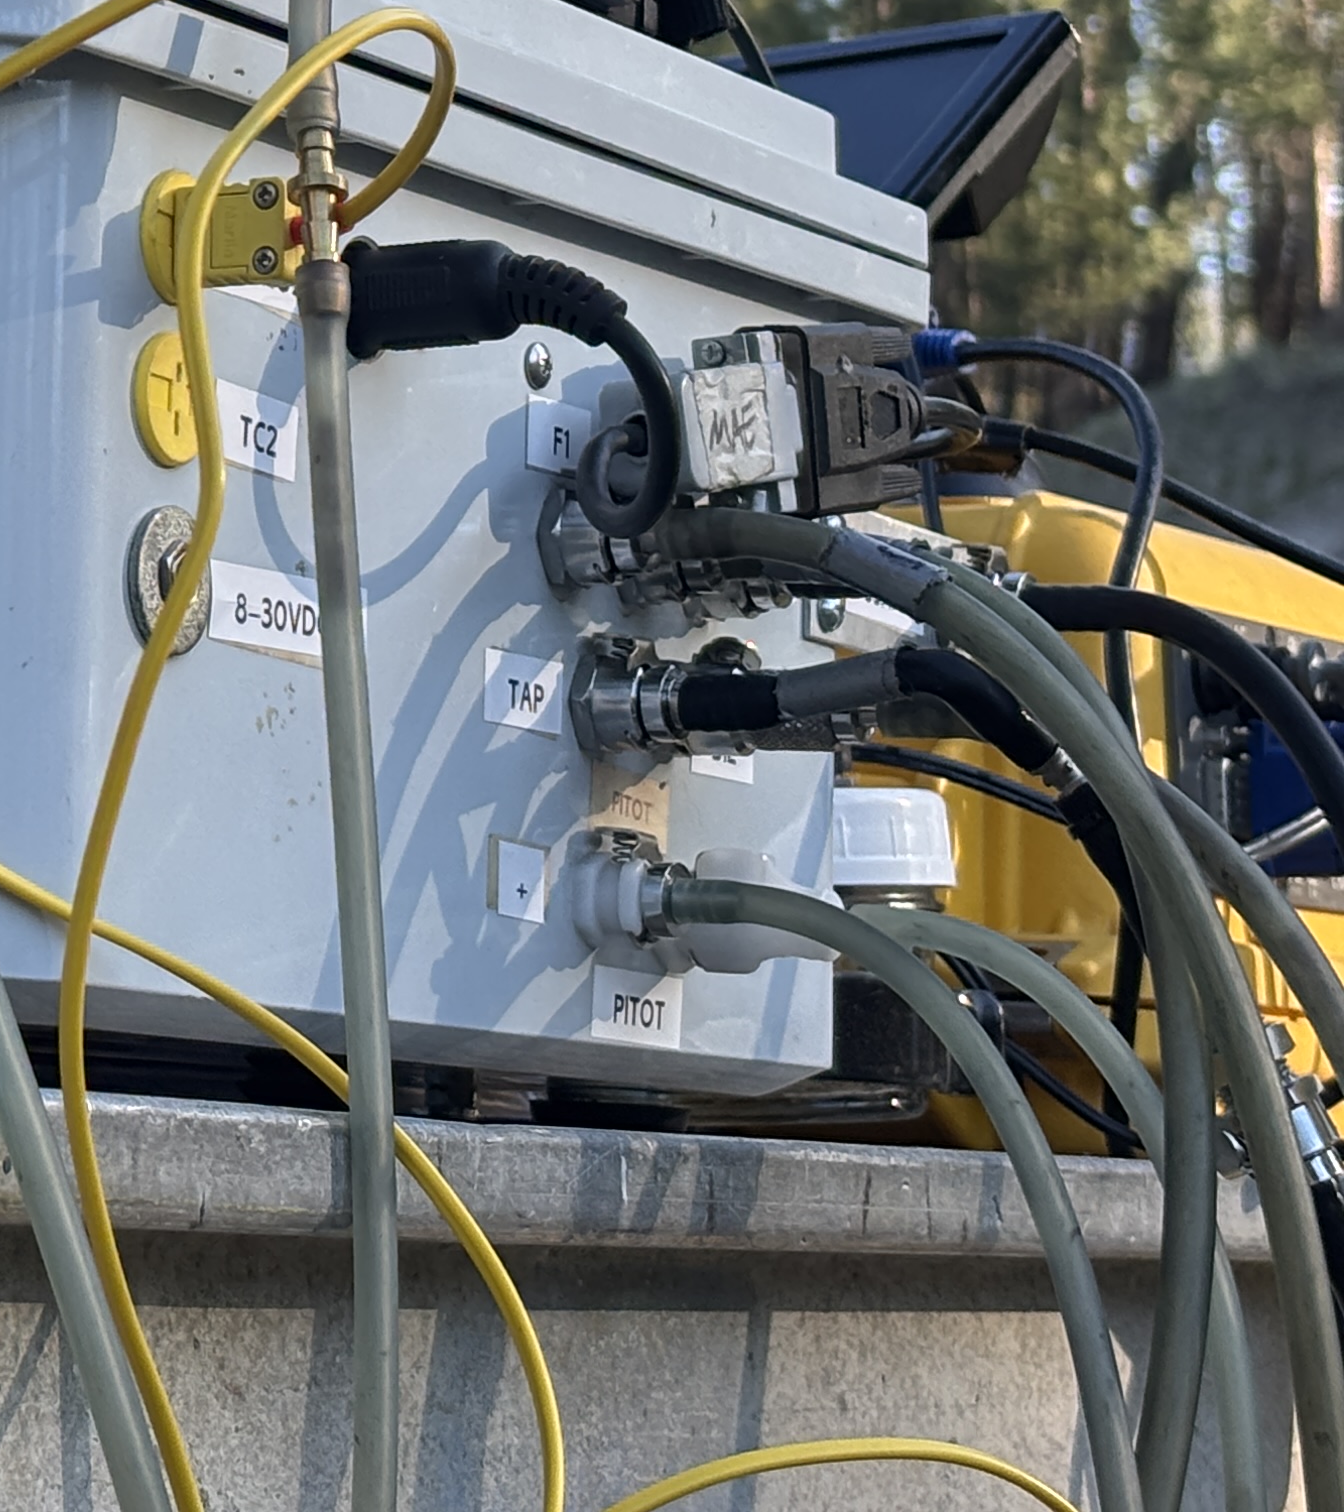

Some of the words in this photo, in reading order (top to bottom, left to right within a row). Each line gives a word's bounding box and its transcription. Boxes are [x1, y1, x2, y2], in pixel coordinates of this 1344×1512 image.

[240, 414, 278, 458] TC2
[553, 426, 570, 459] F1
[234, 593, 322, 637] 8-30VD
[508, 678, 544, 713] TAP
[612, 791, 653, 825] PITOT
[613, 993, 666, 1030] PITOT
